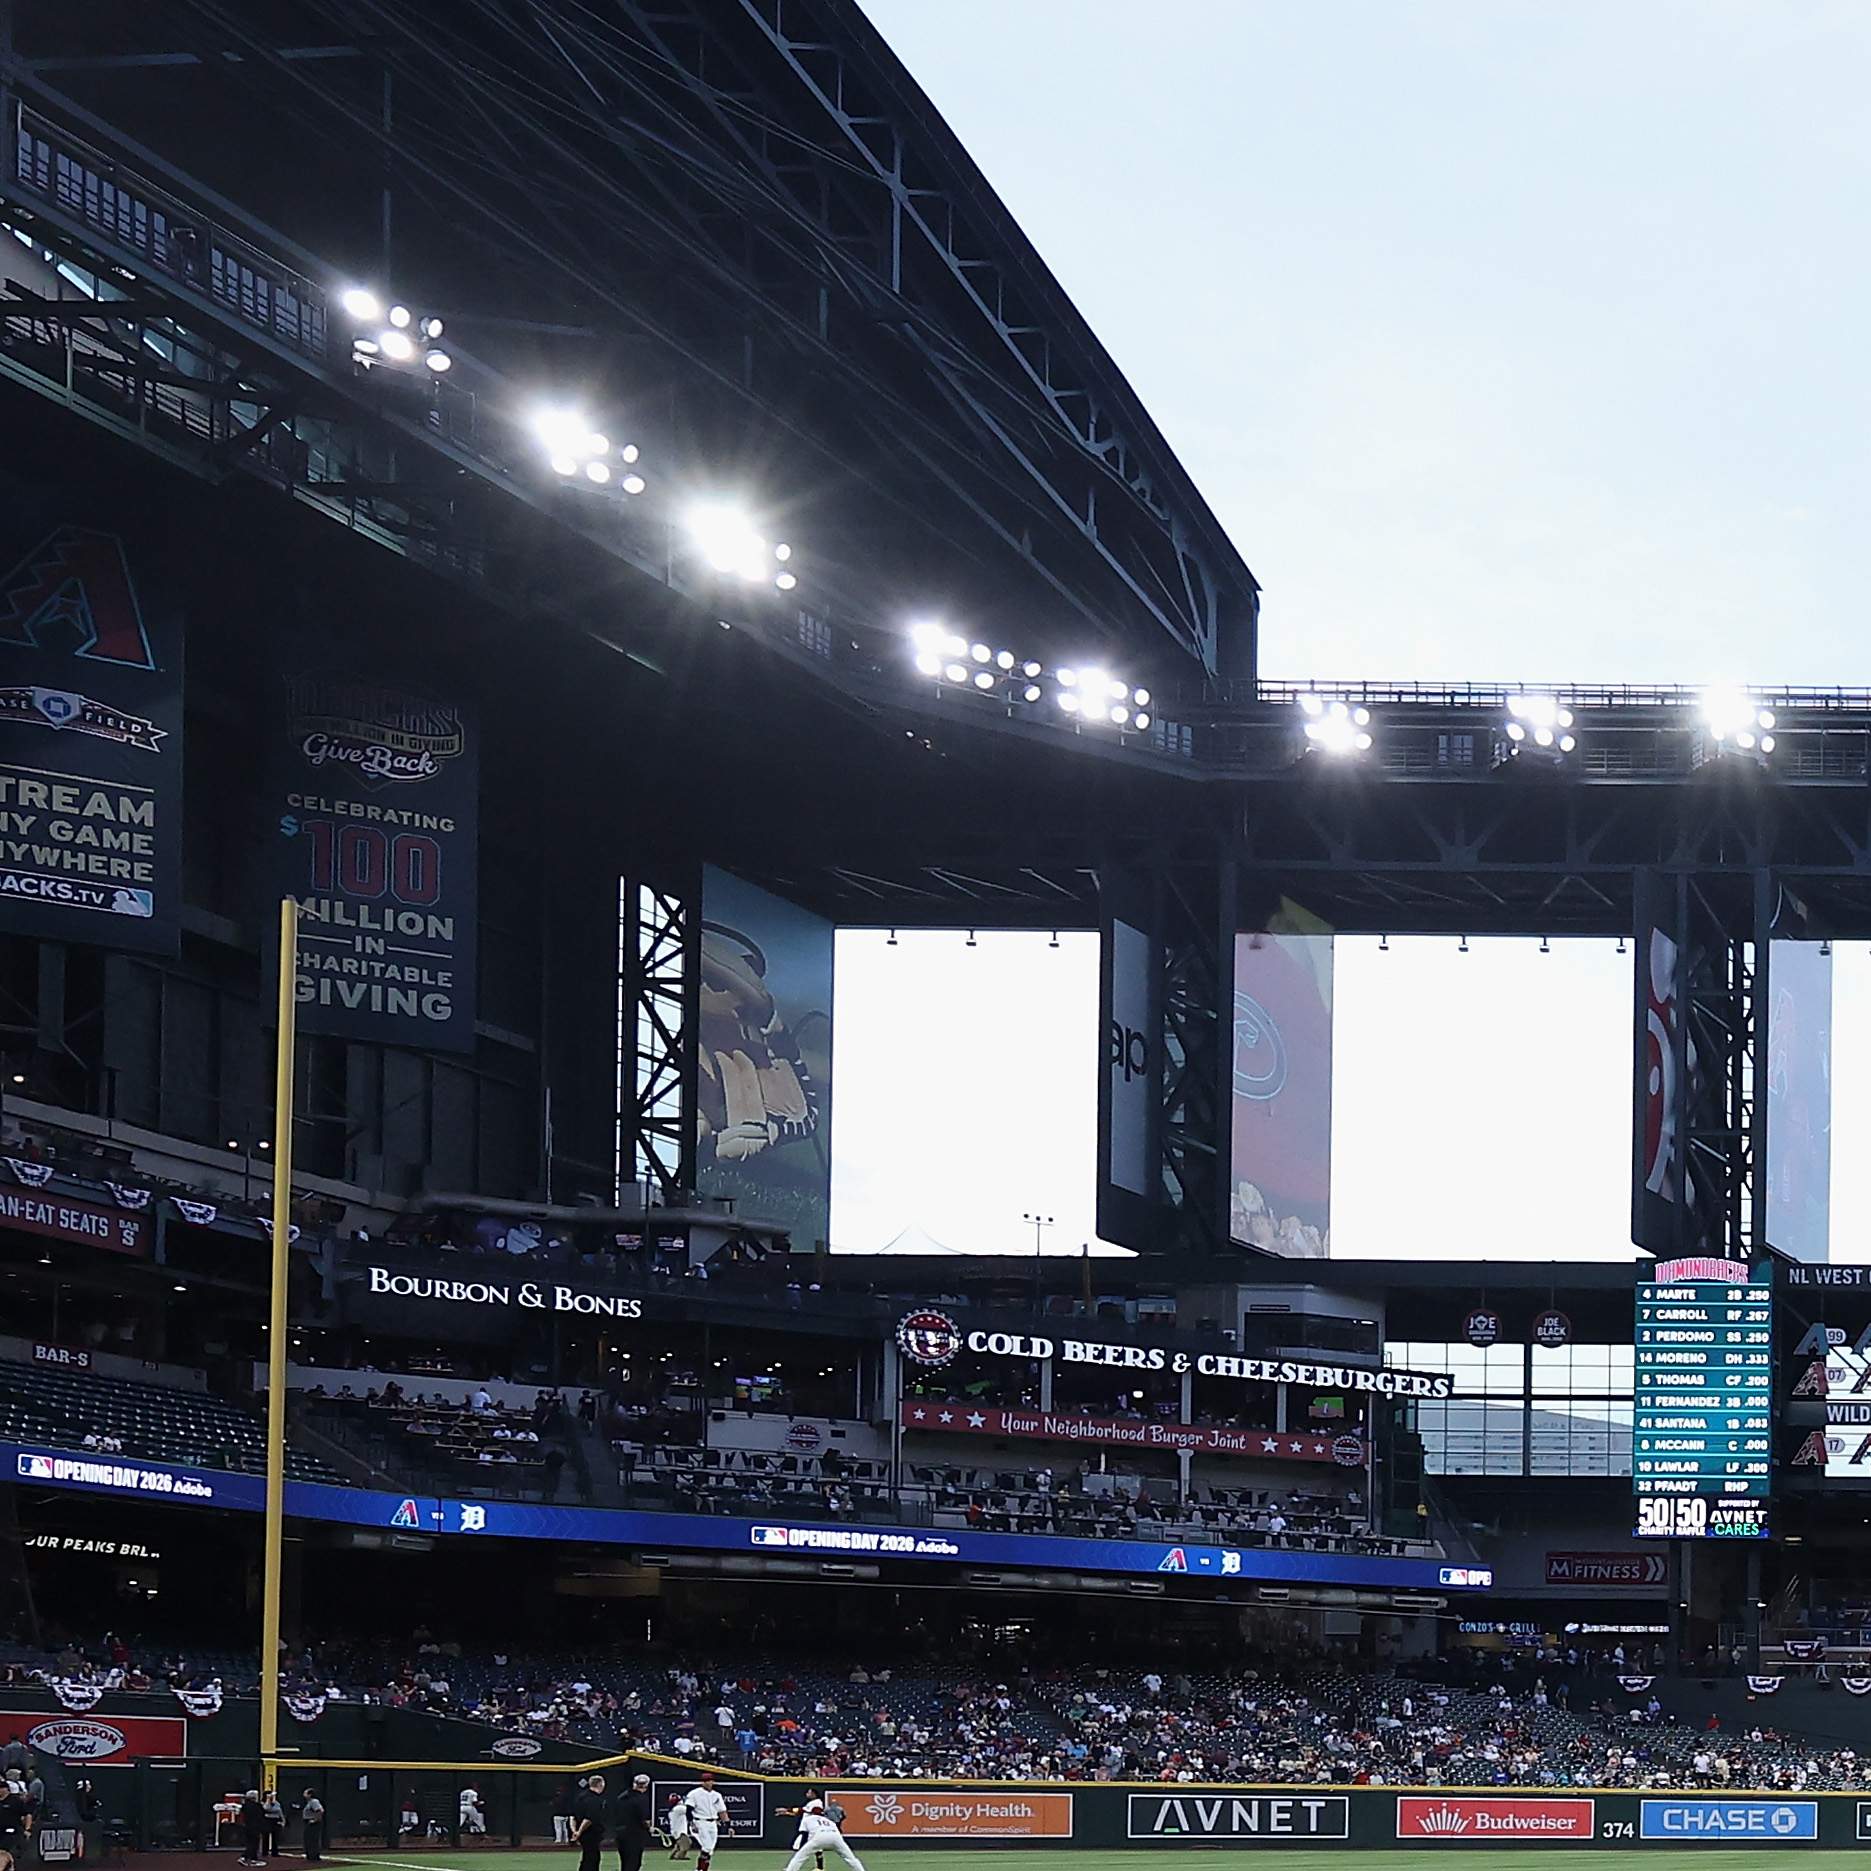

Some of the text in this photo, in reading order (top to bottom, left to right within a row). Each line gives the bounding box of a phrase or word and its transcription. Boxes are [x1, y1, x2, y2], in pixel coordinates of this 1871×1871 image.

[85, 711, 143, 734] FIELD
[303, 733, 364, 765] Give
[287, 793, 456, 832] CELEBRATING
[49, 820, 154, 856] GAME
[354, 935, 385, 955] IN
[295, 974, 452, 1021] GIVING
[59, 1207, 109, 1238] SEATS
[1655, 1257, 1748, 1283] DIAMONDBACKS
[1788, 1268, 1811, 1285] NL
[1816, 1269, 1864, 1285] WEST
[518, 1284, 547, 1310] &
[1656, 1290, 1696, 1300] MARTE
[1656, 1310, 1708, 1320] CARROLL
[1656, 1331, 1715, 1342] PERDOMO
[34, 1345, 90, 1368] BAR-S
[968, 1331, 1054, 1359] COLD
[1062, 1340, 1166, 1370] BEERS
[1172, 1352, 1192, 1373] &
[1197, 1354, 1450, 1398] CHEESEBURGERS
[1656, 1353, 1707, 1363] MORENO
[1655, 1375, 1705, 1385] THOMAS
[1655, 1397, 1721, 1407] FERNANDEZ
[1654, 1419, 1707, 1429] SANTANA
[1827, 1405, 1871, 1424] WILD
[1001, 1412, 1246, 1450] Your Neighborhood Burger Joint
[54, 1460, 213, 1498] OPENING 2026 Adobe
[1710, 1510, 1767, 1523] AVNET
[1715, 1524, 1760, 1536] CARES
[63, 1538, 115, 1554] PEAKS
[789, 1529, 959, 1555] OPENING 2026 Adobe
[1574, 1565, 1641, 1579] FITNESS
[35, 1725, 118, 1745] SANDERSON
[911, 1803, 1032, 1821] Dignity Health
[1154, 1800, 1327, 1833] AVNET
[1475, 1812, 1576, 1832] Budweiser
[1664, 1808, 1766, 1831] CHASE
[1603, 1822, 1635, 1839] 374
